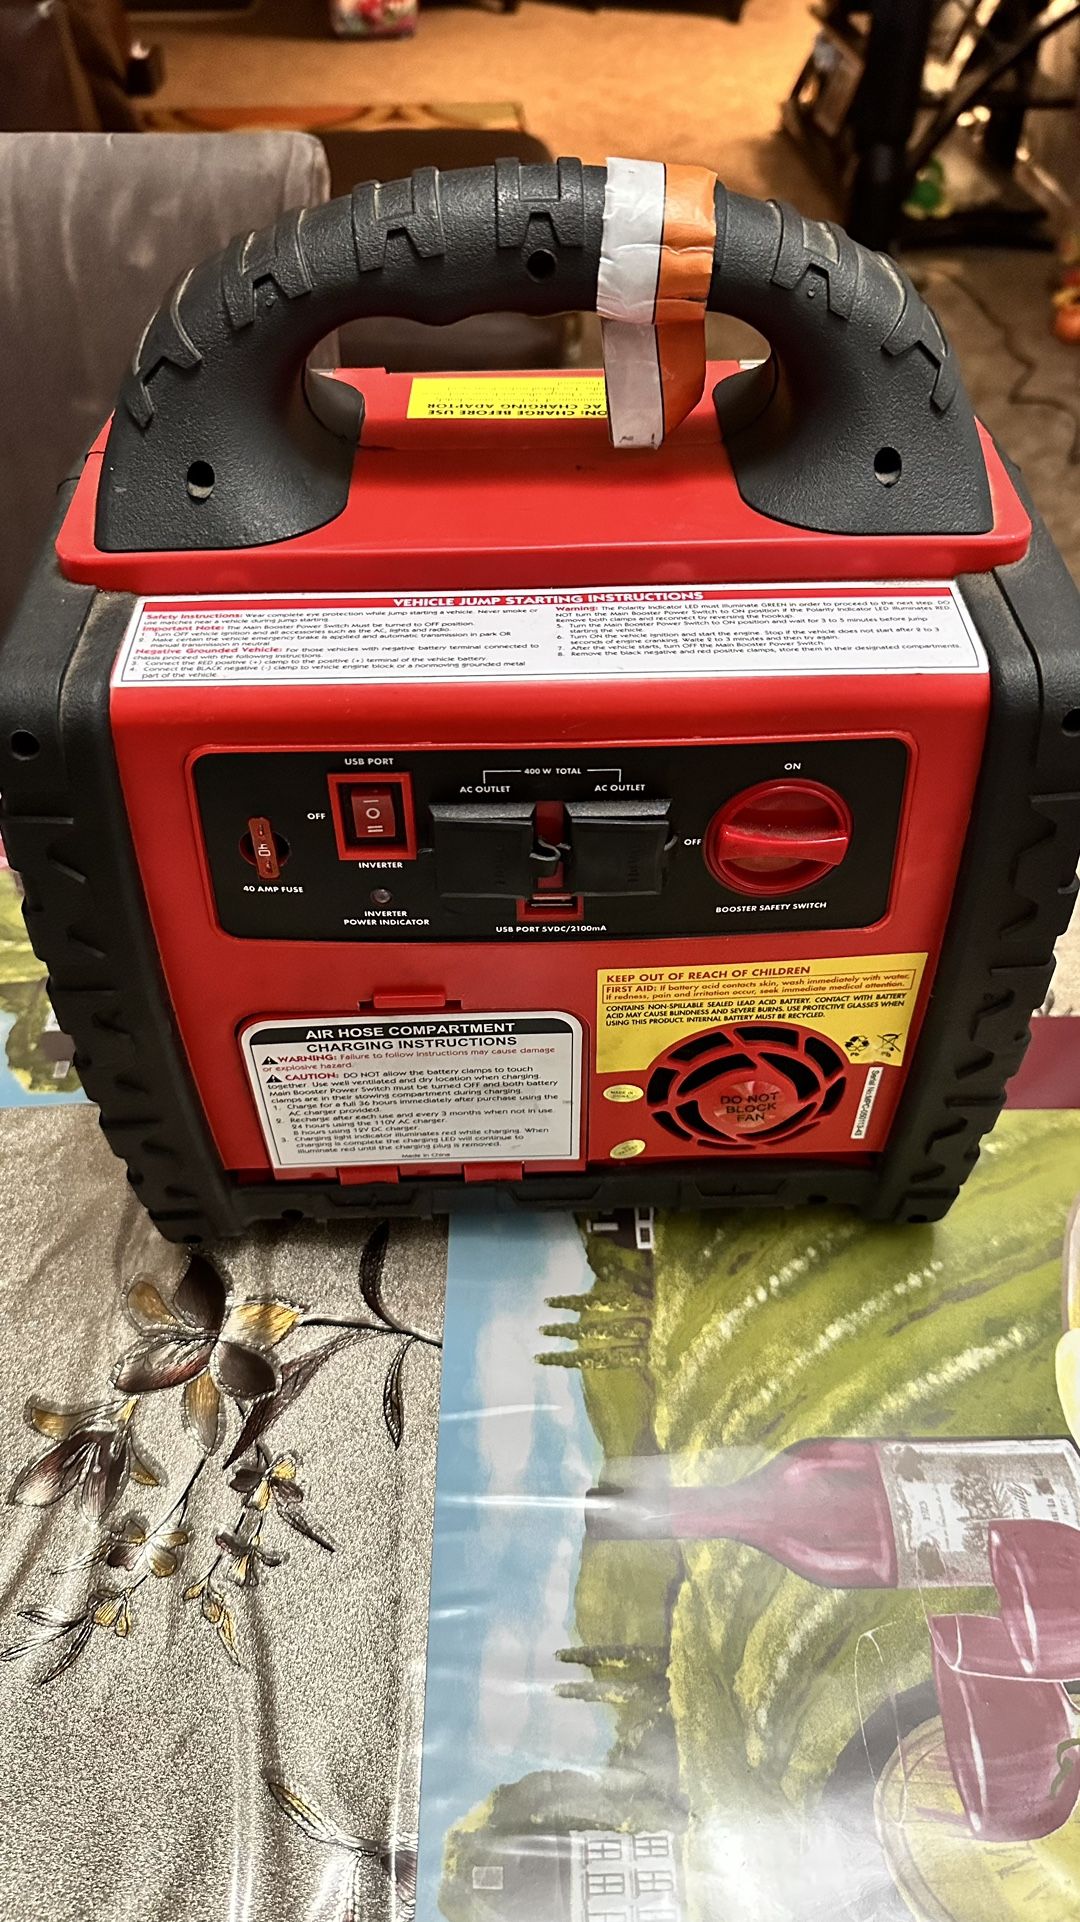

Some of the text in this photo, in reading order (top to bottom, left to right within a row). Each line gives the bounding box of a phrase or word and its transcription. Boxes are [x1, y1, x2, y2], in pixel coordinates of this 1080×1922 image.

[394, 592, 704, 607] VEHICLE JUMP STARTING INSTRUCTIONS
[716, 905, 757, 913] BOOSTER
[607, 974, 635, 983] KEEP
[639, 973, 665, 982] OUT
[668, 972, 684, 980] OF
[688, 970, 727, 980] REACH
[752, 966, 811, 976] CHILDREN
[668, 983, 700, 992] battery
[807, 976, 860, 985] immediately
[782, 985, 827, 993] immediate
[648, 1002, 704, 1010] NON-SPILLABLE
[802, 1003, 845, 1011] PROTECTIVE
[306, 1023, 516, 1039] AIR HOSE COMPARTMENT
[306, 1036, 517, 1053] CHARGING INSTRUCTIONS
[278, 1054, 337, 1063] WARNING:
[520, 1047, 555, 1055] damage
[275, 1064, 318, 1072] explosive
[285, 1072, 339, 1081] CAUTION:
[869, 1070, 880, 1086] Serial
[720, 1092, 779, 1104] DO NOT
[726, 1103, 777, 1114] BLOCK
[736, 1113, 765, 1122] FAN
